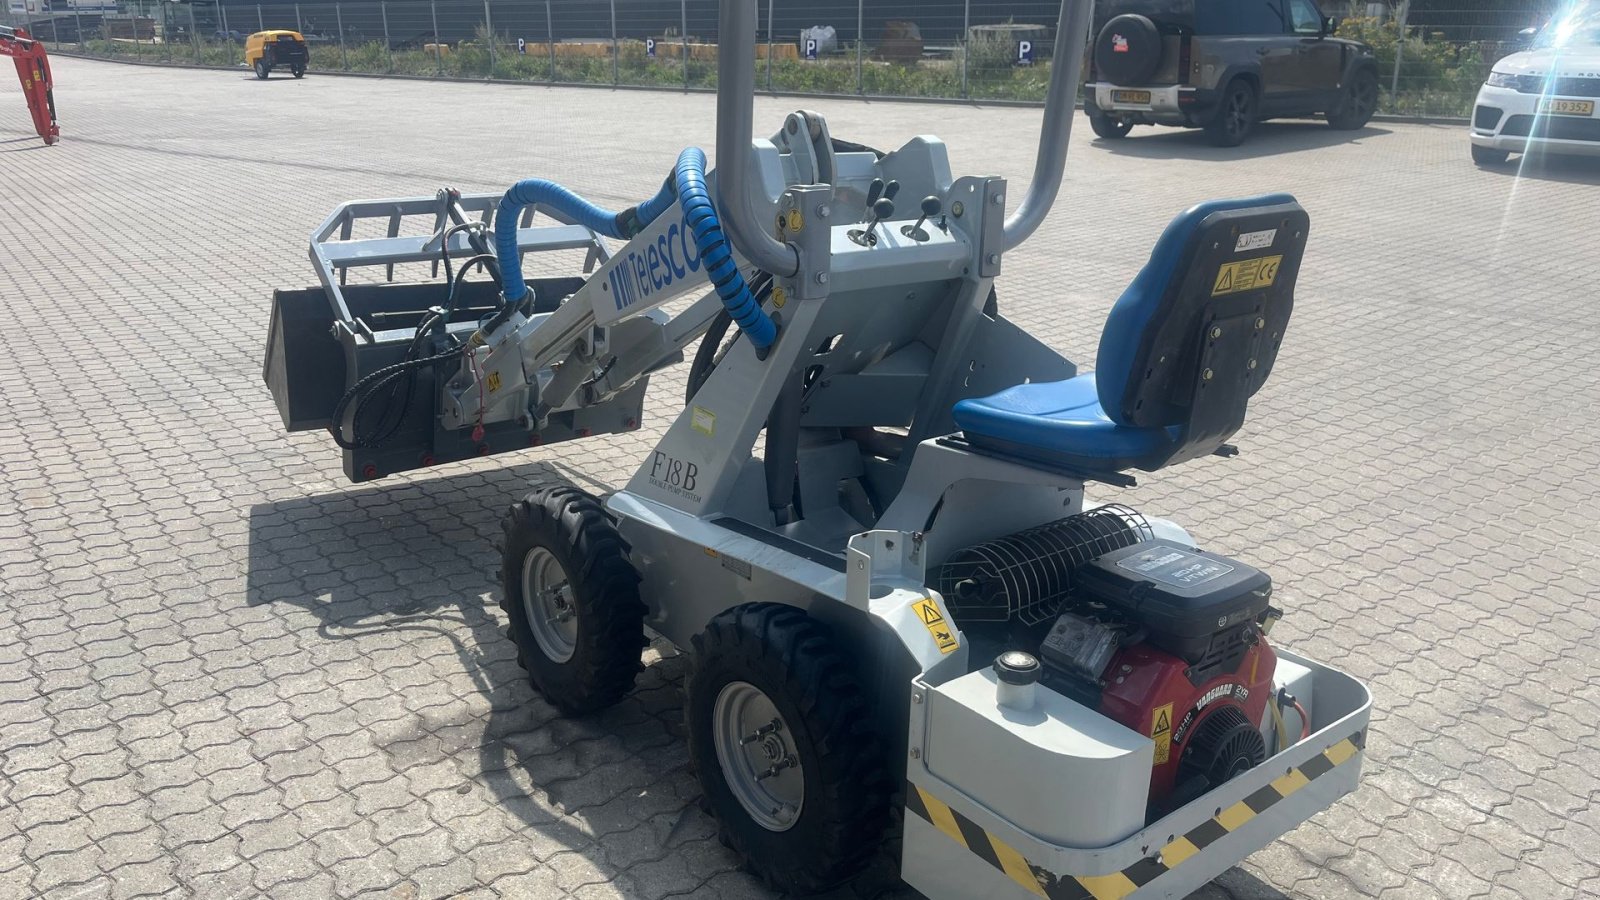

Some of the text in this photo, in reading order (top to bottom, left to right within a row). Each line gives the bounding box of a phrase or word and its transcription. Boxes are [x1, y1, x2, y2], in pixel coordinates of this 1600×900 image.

[518, 38, 525, 51] P
[646, 39, 654, 53] P
[807, 40, 816, 56] P
[1019, 41, 1031, 59] P
[628, 215, 731, 299] Telesco
[681, 489, 702, 503] SYSTEM
[1197, 684, 1233, 710] VANGUARD
